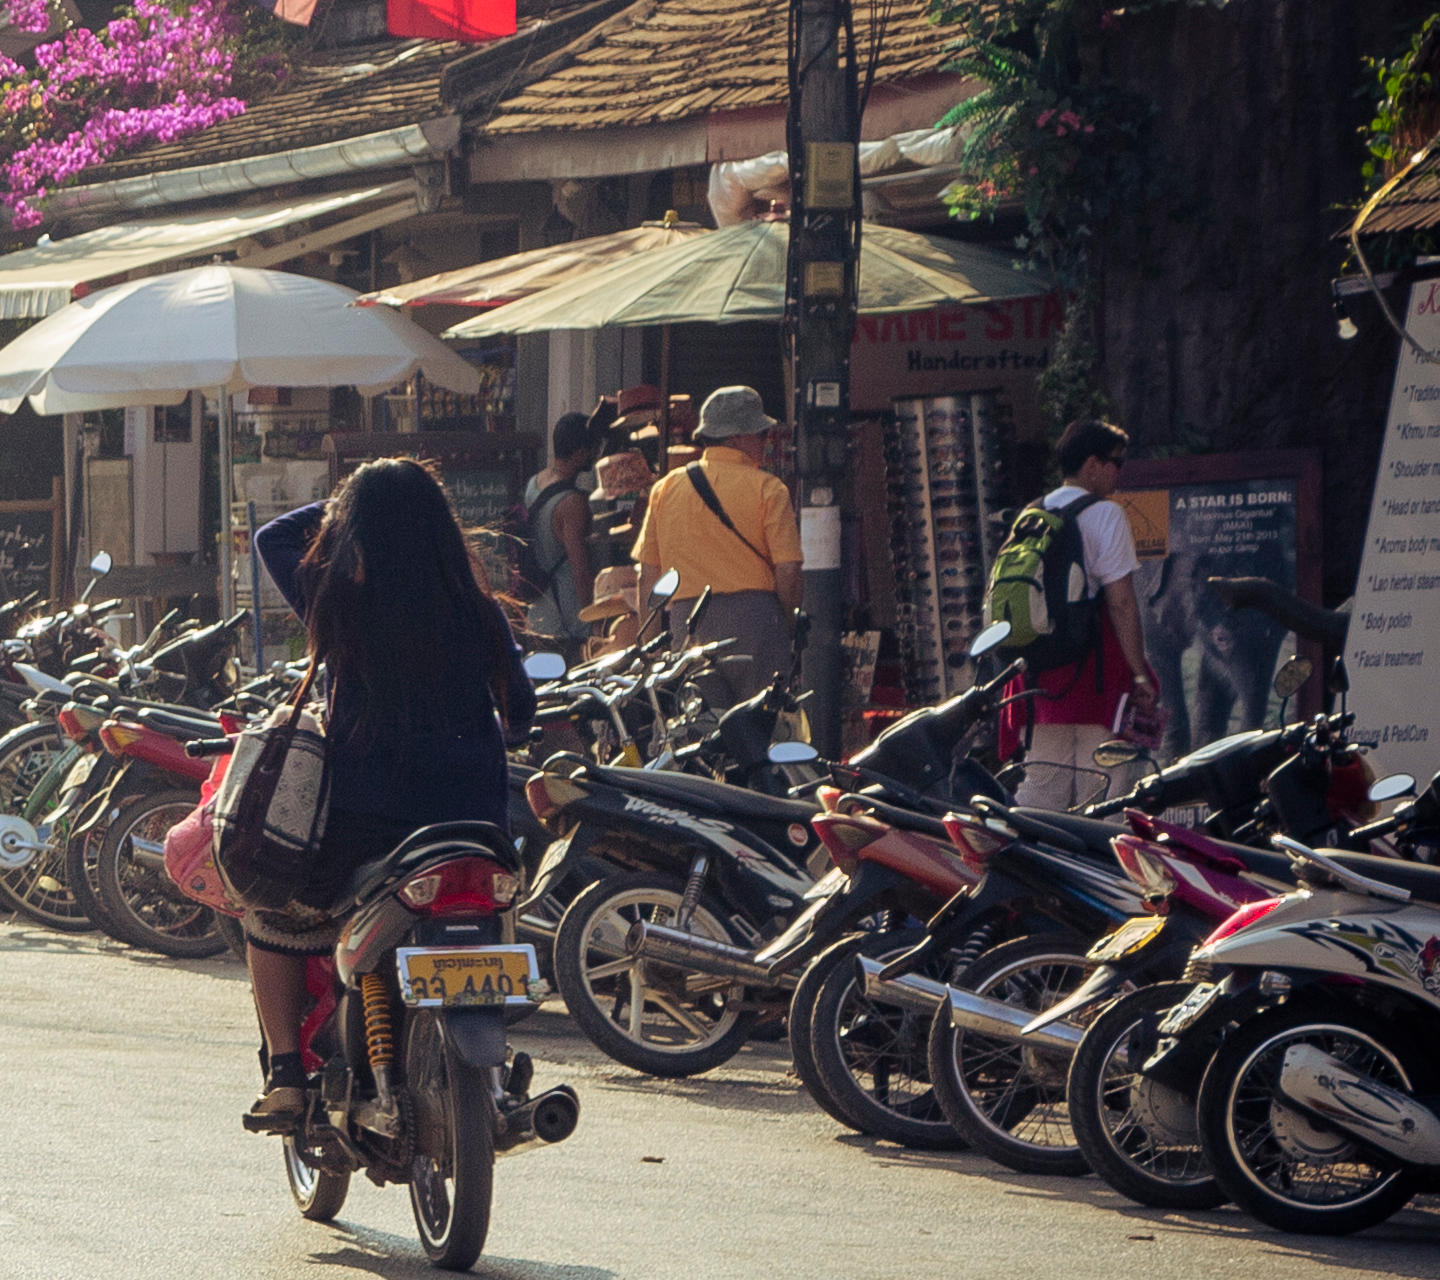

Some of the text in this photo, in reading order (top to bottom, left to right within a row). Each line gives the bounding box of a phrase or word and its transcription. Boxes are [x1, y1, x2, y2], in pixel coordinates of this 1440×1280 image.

[906, 349, 1051, 372] Handcrafted
[1175, 491, 1293, 510] A STAR IS BORN:
[1365, 612, 1413, 634] Body polish
[1359, 650, 1425, 668] Facial treatment
